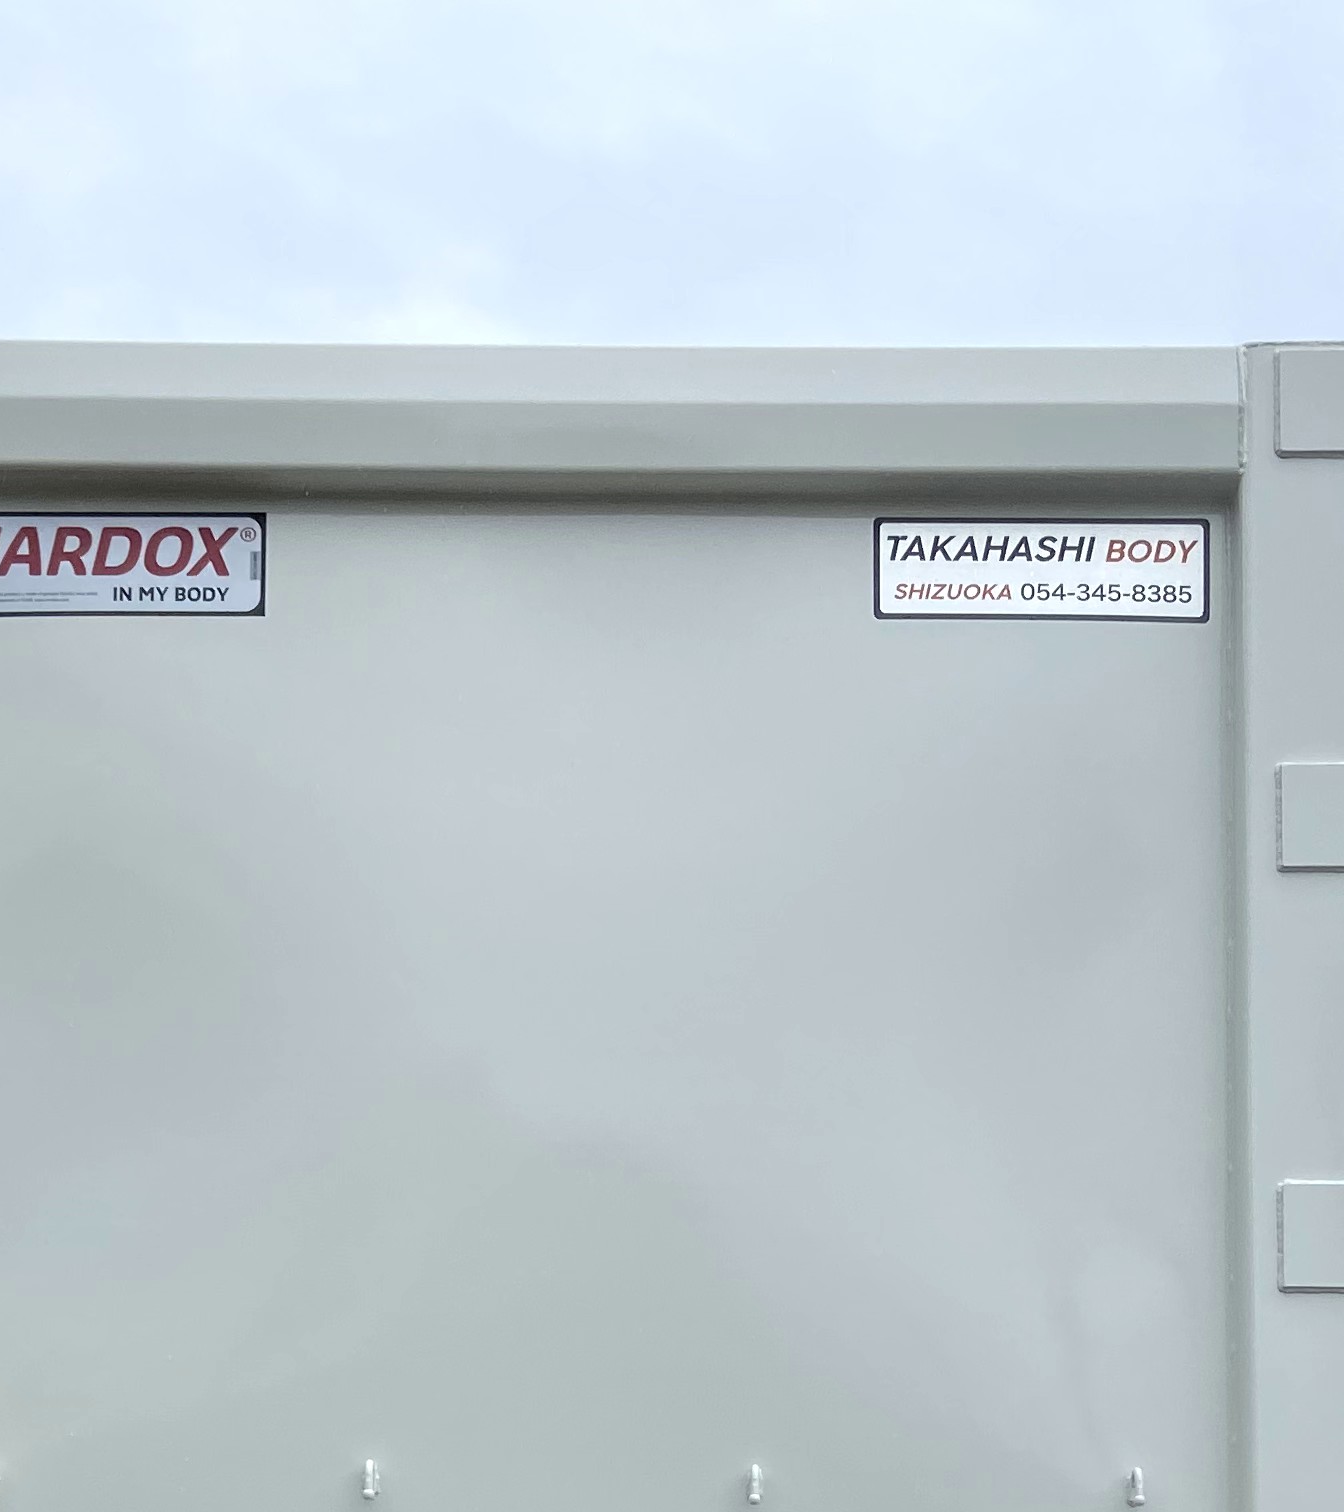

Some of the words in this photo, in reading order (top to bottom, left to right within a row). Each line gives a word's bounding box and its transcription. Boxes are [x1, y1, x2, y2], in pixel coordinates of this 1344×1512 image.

[886, 535, 1096, 562] TAKAHASHI
[1105, 540, 1198, 563] BODY
[112, 587, 133, 602] IN
[139, 587, 168, 602] MY
[174, 586, 230, 602] BODY
[894, 583, 1012, 601] SHIZUOKA
[1020, 583, 1193, 604] 054-345-8385
